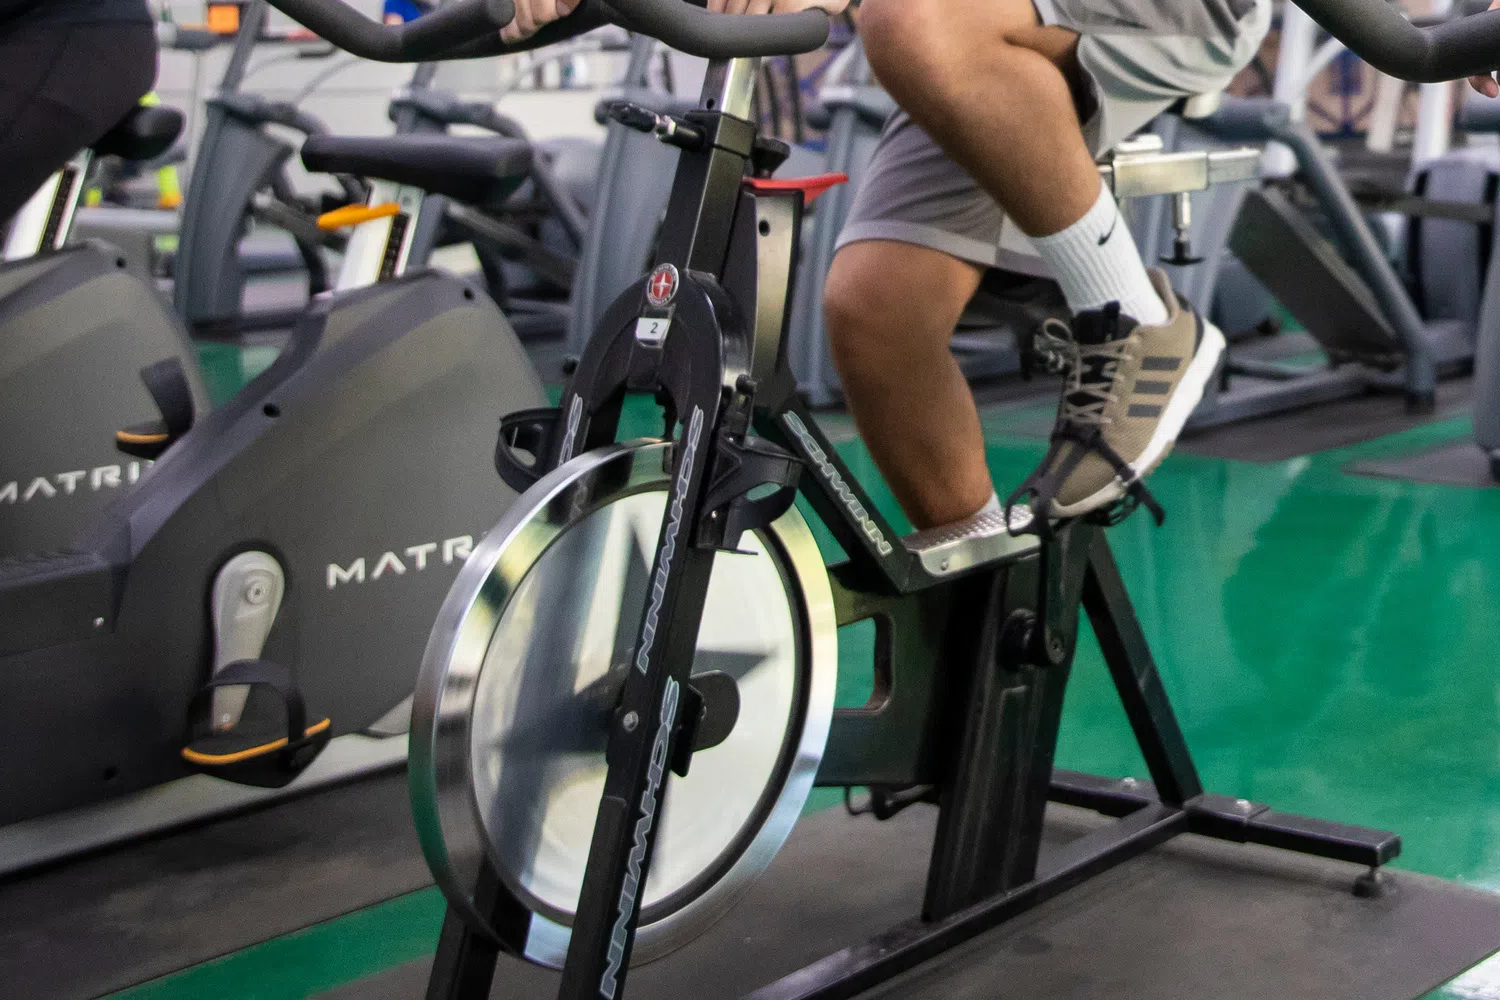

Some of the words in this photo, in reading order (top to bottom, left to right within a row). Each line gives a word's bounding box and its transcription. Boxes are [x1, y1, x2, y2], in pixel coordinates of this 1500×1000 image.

[650, 321, 659, 334] 2
[0, 461, 156, 504] MATRI
[636, 404, 704, 675] SCHWINN
[781, 409, 894, 556] SCHWINN
[599, 674, 681, 1000] SCHWINN
